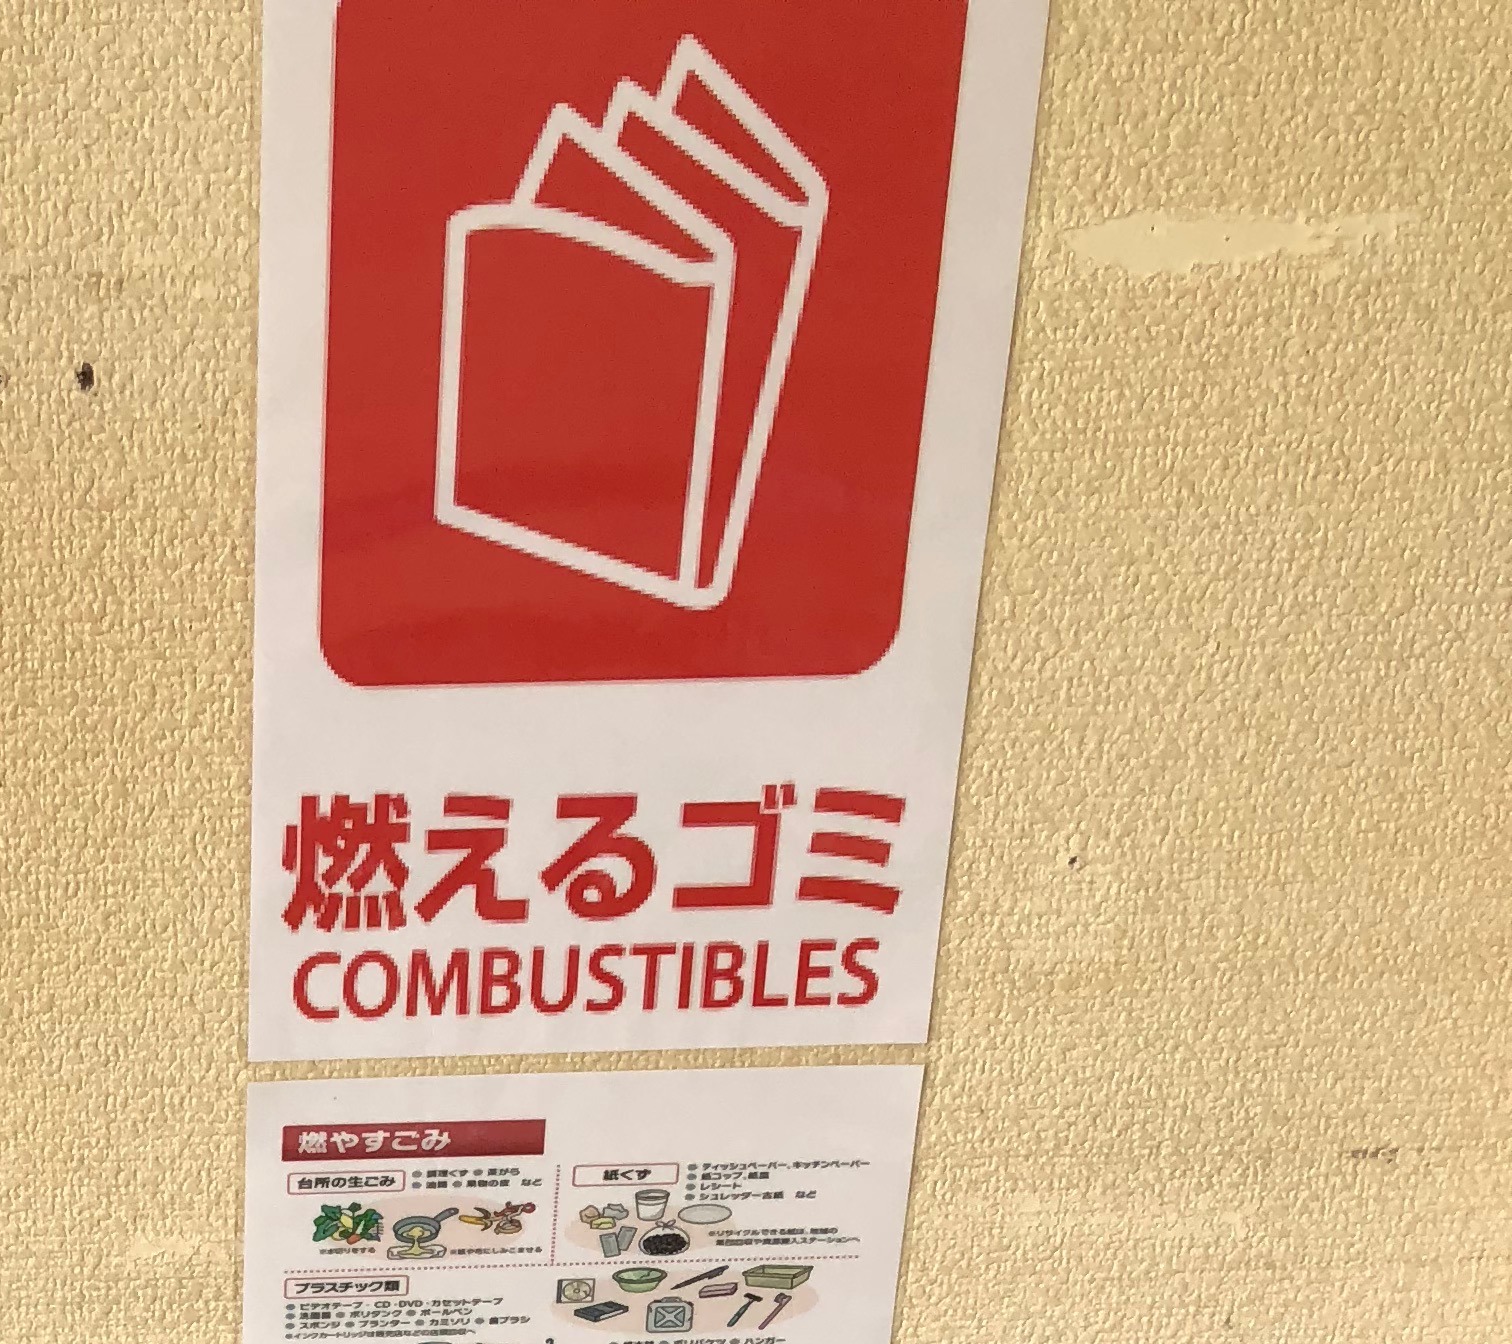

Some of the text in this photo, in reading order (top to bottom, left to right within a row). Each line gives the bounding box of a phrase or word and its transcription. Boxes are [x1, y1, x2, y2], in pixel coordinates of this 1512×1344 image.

[282, 782, 905, 932] 燃えるゴミ
[293, 937, 880, 1021] COMBUSTIBLES
[298, 1129, 451, 1154] 燃やすごみ
[297, 1175, 396, 1189] 台所の生ごみ
[603, 1168, 652, 1181] 紙くず
[294, 1281, 400, 1294] プラスチック類
